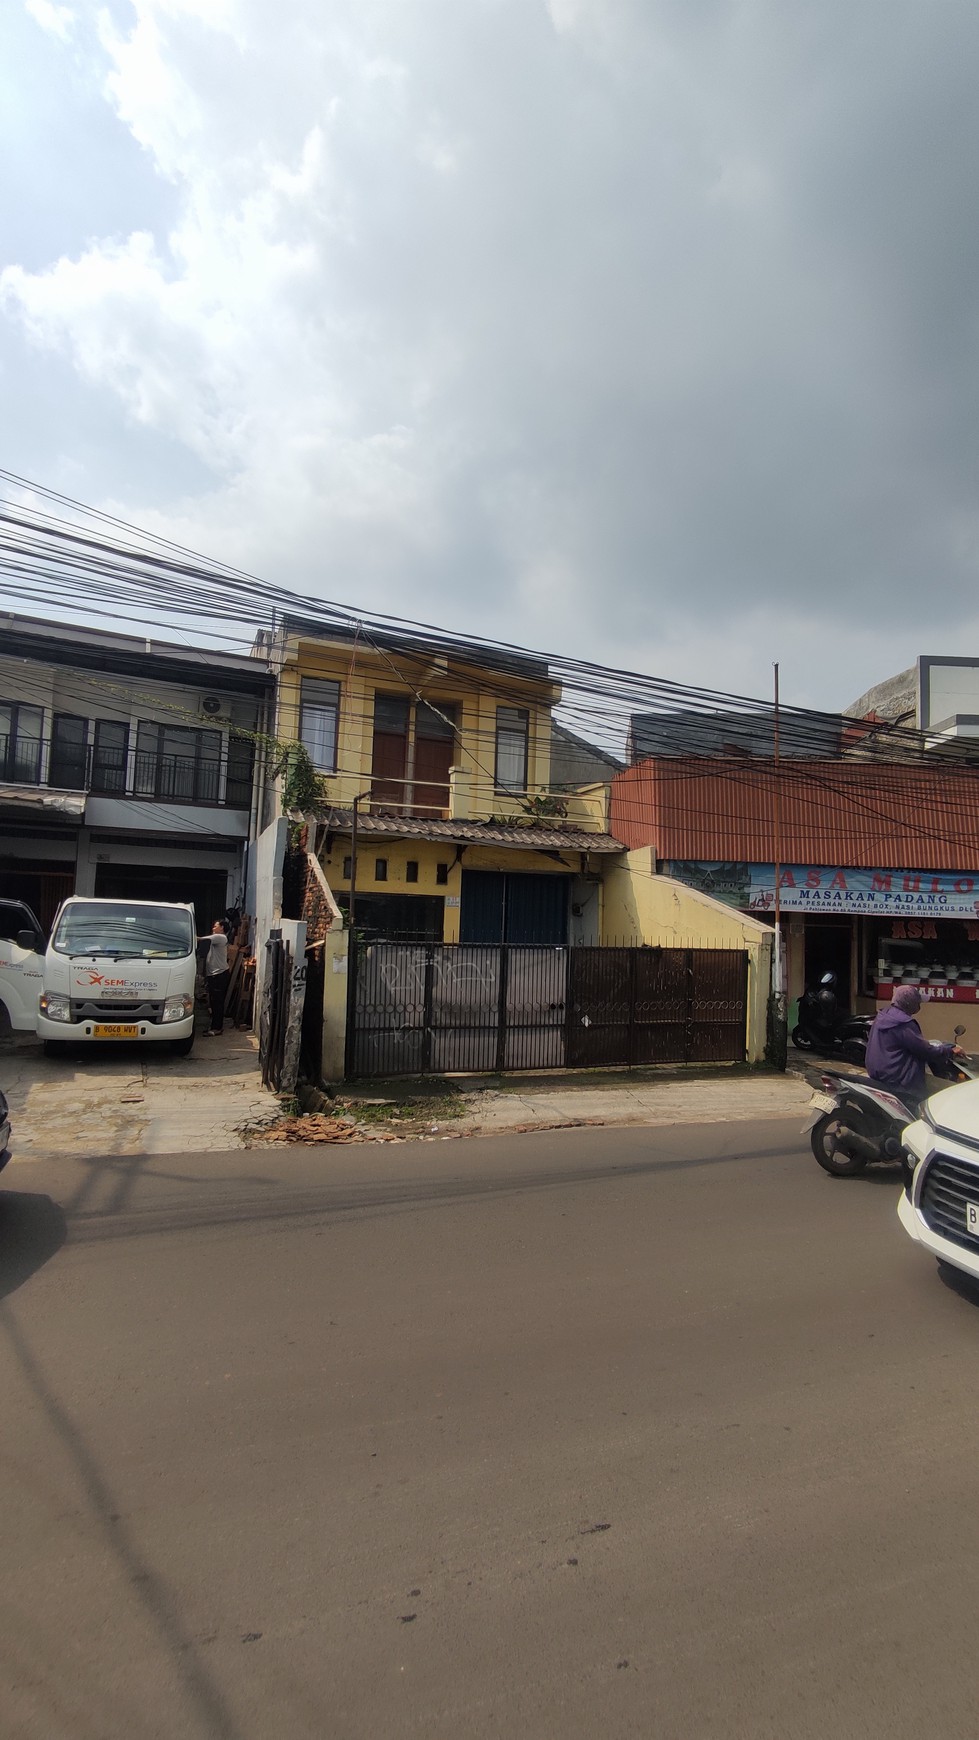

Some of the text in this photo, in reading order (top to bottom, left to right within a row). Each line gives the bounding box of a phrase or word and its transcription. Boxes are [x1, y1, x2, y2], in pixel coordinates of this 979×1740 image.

[779, 869, 847, 888] ASA
[870, 872, 974, 893] MULO
[799, 890, 947, 904] MASAKAN PADANG
[892, 921, 938, 939] ASA
[893, 985, 954, 999] AKAN
[969, 1207, 977, 1224] B
